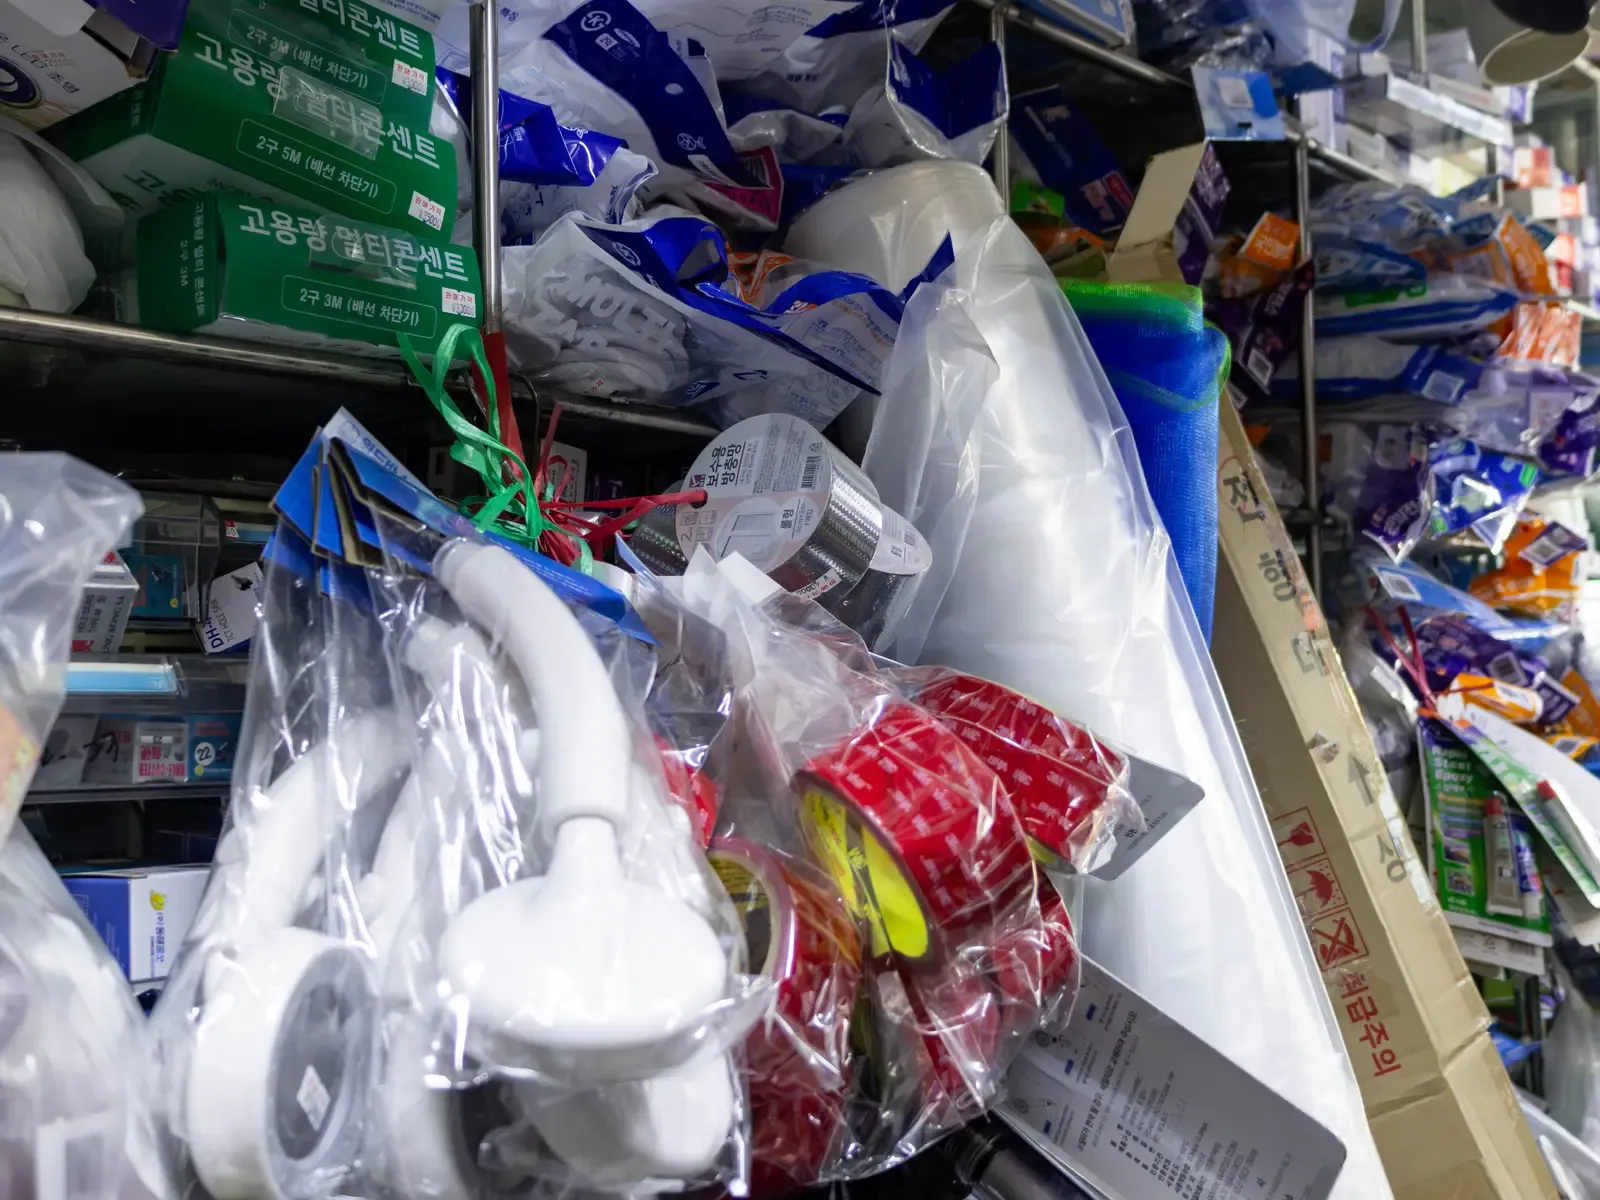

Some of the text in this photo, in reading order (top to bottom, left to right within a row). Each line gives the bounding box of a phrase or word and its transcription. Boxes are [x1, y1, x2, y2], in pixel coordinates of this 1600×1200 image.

[194, 32, 289, 100] 고용량
[246, 25, 369, 89] 2구 3M (배선 차단기)
[256, 135, 379, 199] 2구 5M (배선 차단기)
[238, 204, 469, 282] 고용량 멀티콘센트
[300, 288, 420, 328] 2구 3M (배선 차단기)
[706, 444, 726, 487] 보수용
[721, 444, 741, 485] 방충망
[1340, 972, 1402, 1076] 취급주의
